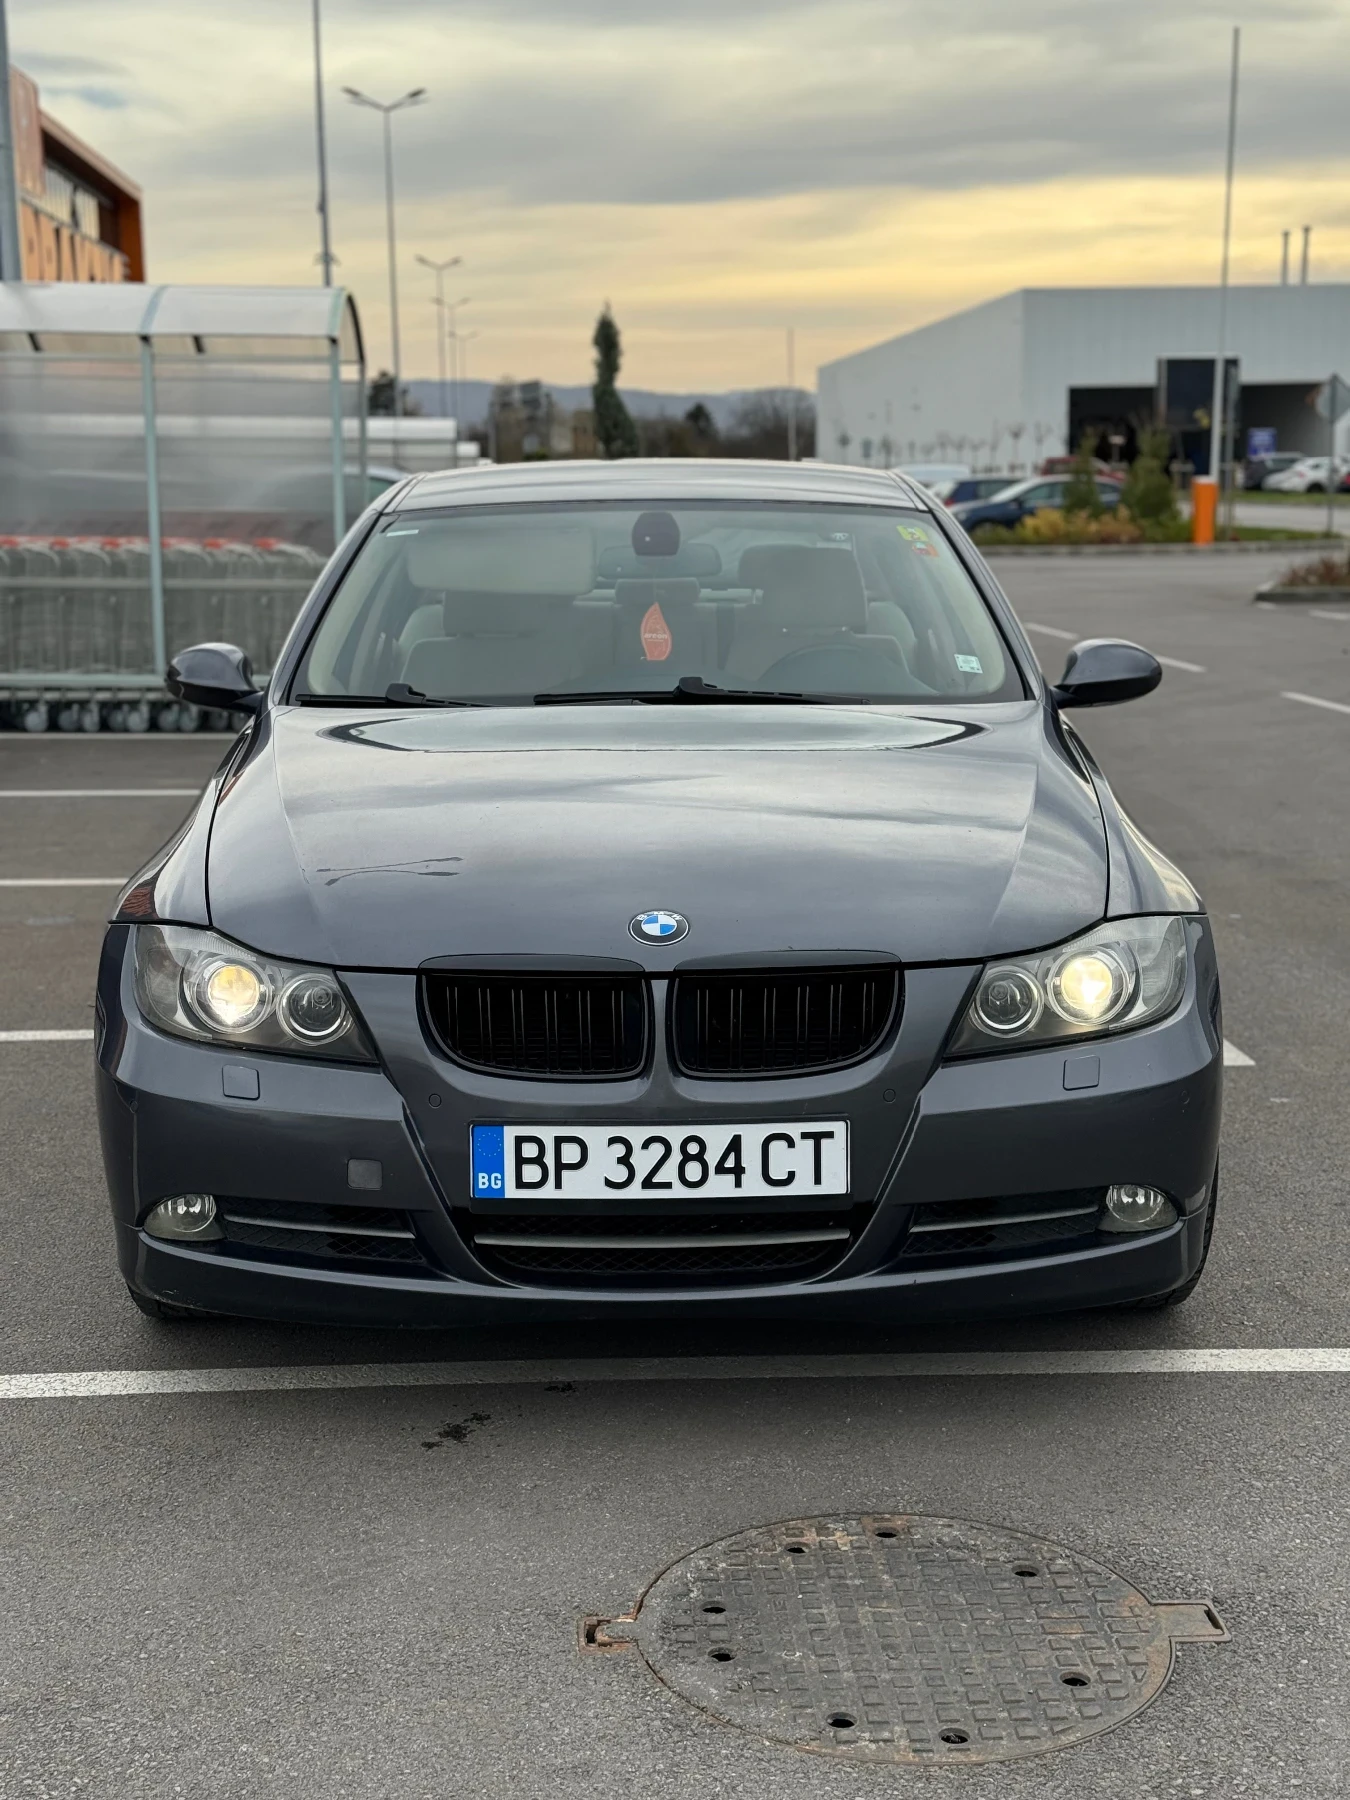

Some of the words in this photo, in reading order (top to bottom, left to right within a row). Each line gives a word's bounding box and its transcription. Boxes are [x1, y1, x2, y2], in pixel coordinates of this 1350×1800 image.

[514, 1135, 589, 1189] BP
[604, 1134, 746, 1189] 3284
[761, 1131, 835, 1187] CT
[478, 1172, 502, 1189] BG
